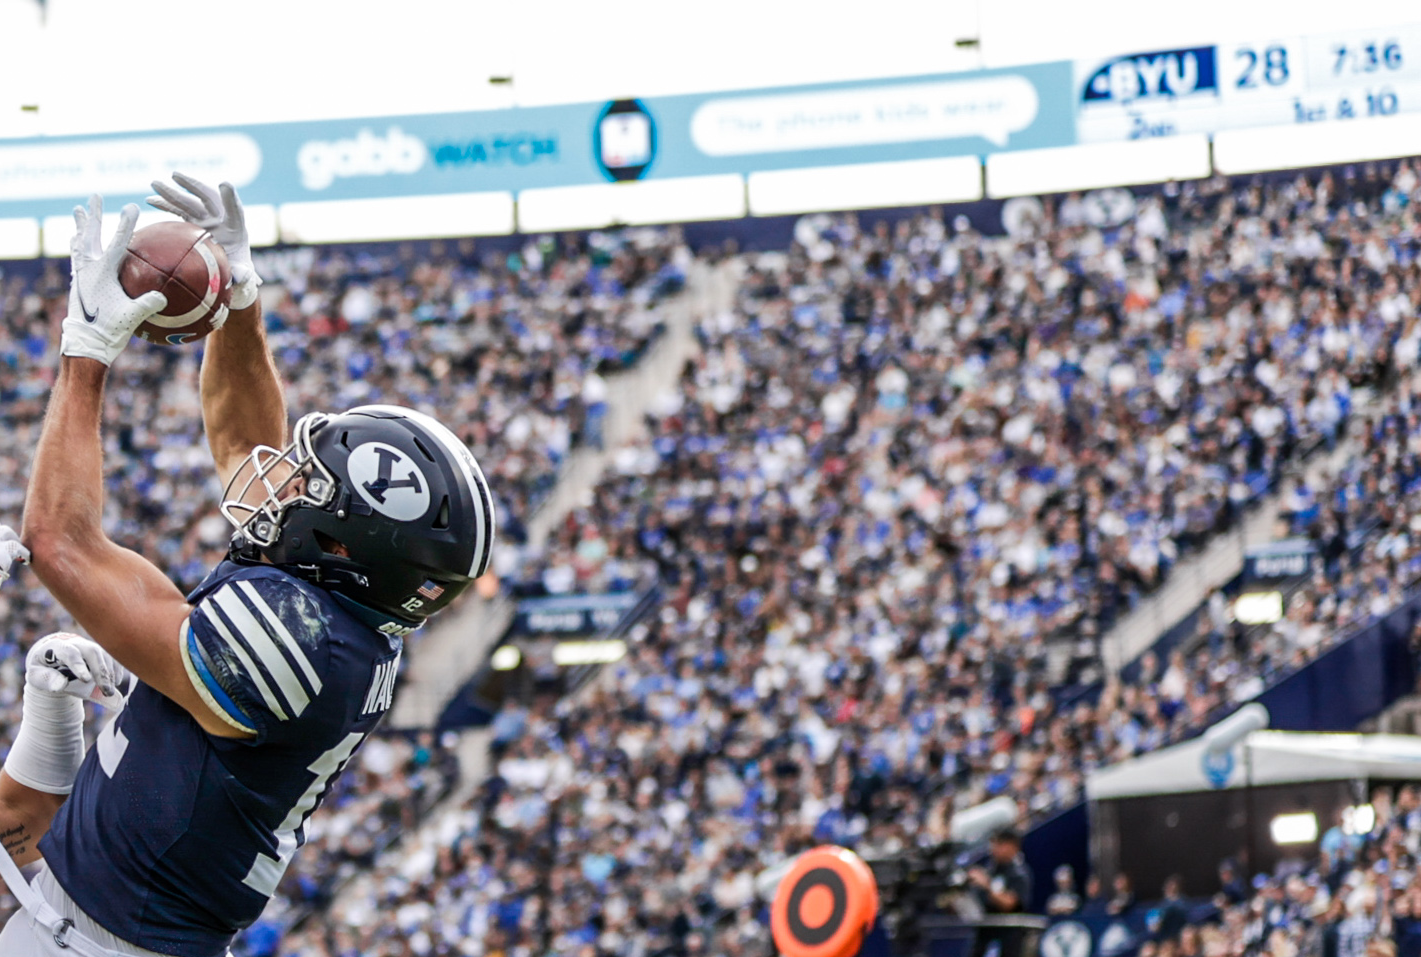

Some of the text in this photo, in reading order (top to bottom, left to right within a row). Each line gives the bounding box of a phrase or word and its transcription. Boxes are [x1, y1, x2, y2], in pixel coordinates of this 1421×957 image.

[1233, 46, 1290, 90] 28
[1331, 38, 1403, 76] 7:36
[297, 128, 559, 191] gabb WATCH
[362, 447, 422, 505] Y
[401, 597, 424, 612] 12
